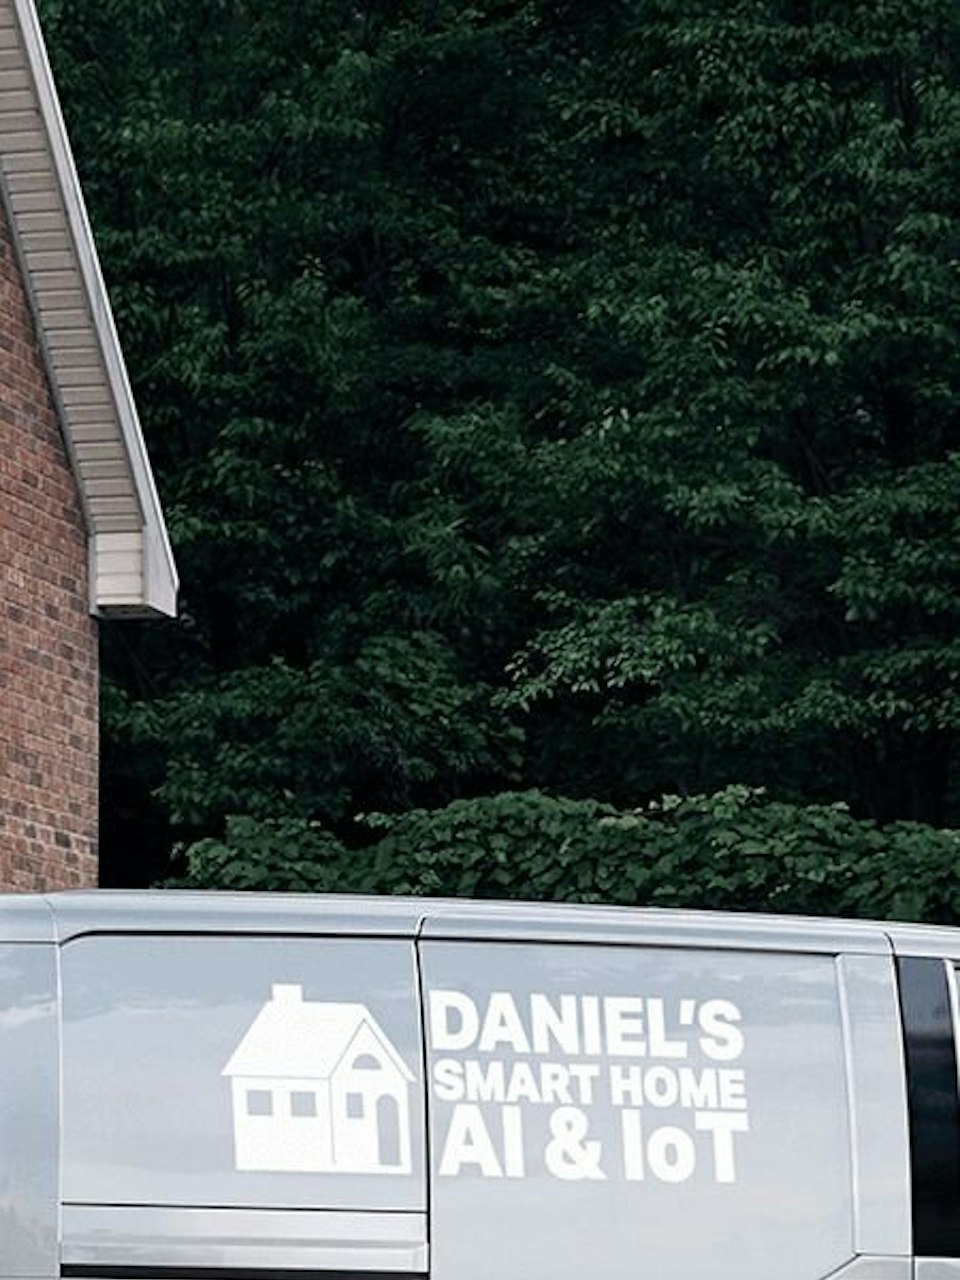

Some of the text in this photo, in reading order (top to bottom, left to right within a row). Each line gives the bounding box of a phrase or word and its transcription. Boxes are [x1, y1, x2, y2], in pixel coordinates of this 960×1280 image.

[429, 990, 744, 1059] DANIEL'S
[433, 1060, 748, 1108] SMART HOME
[439, 1104, 750, 1183] AI & IoT
